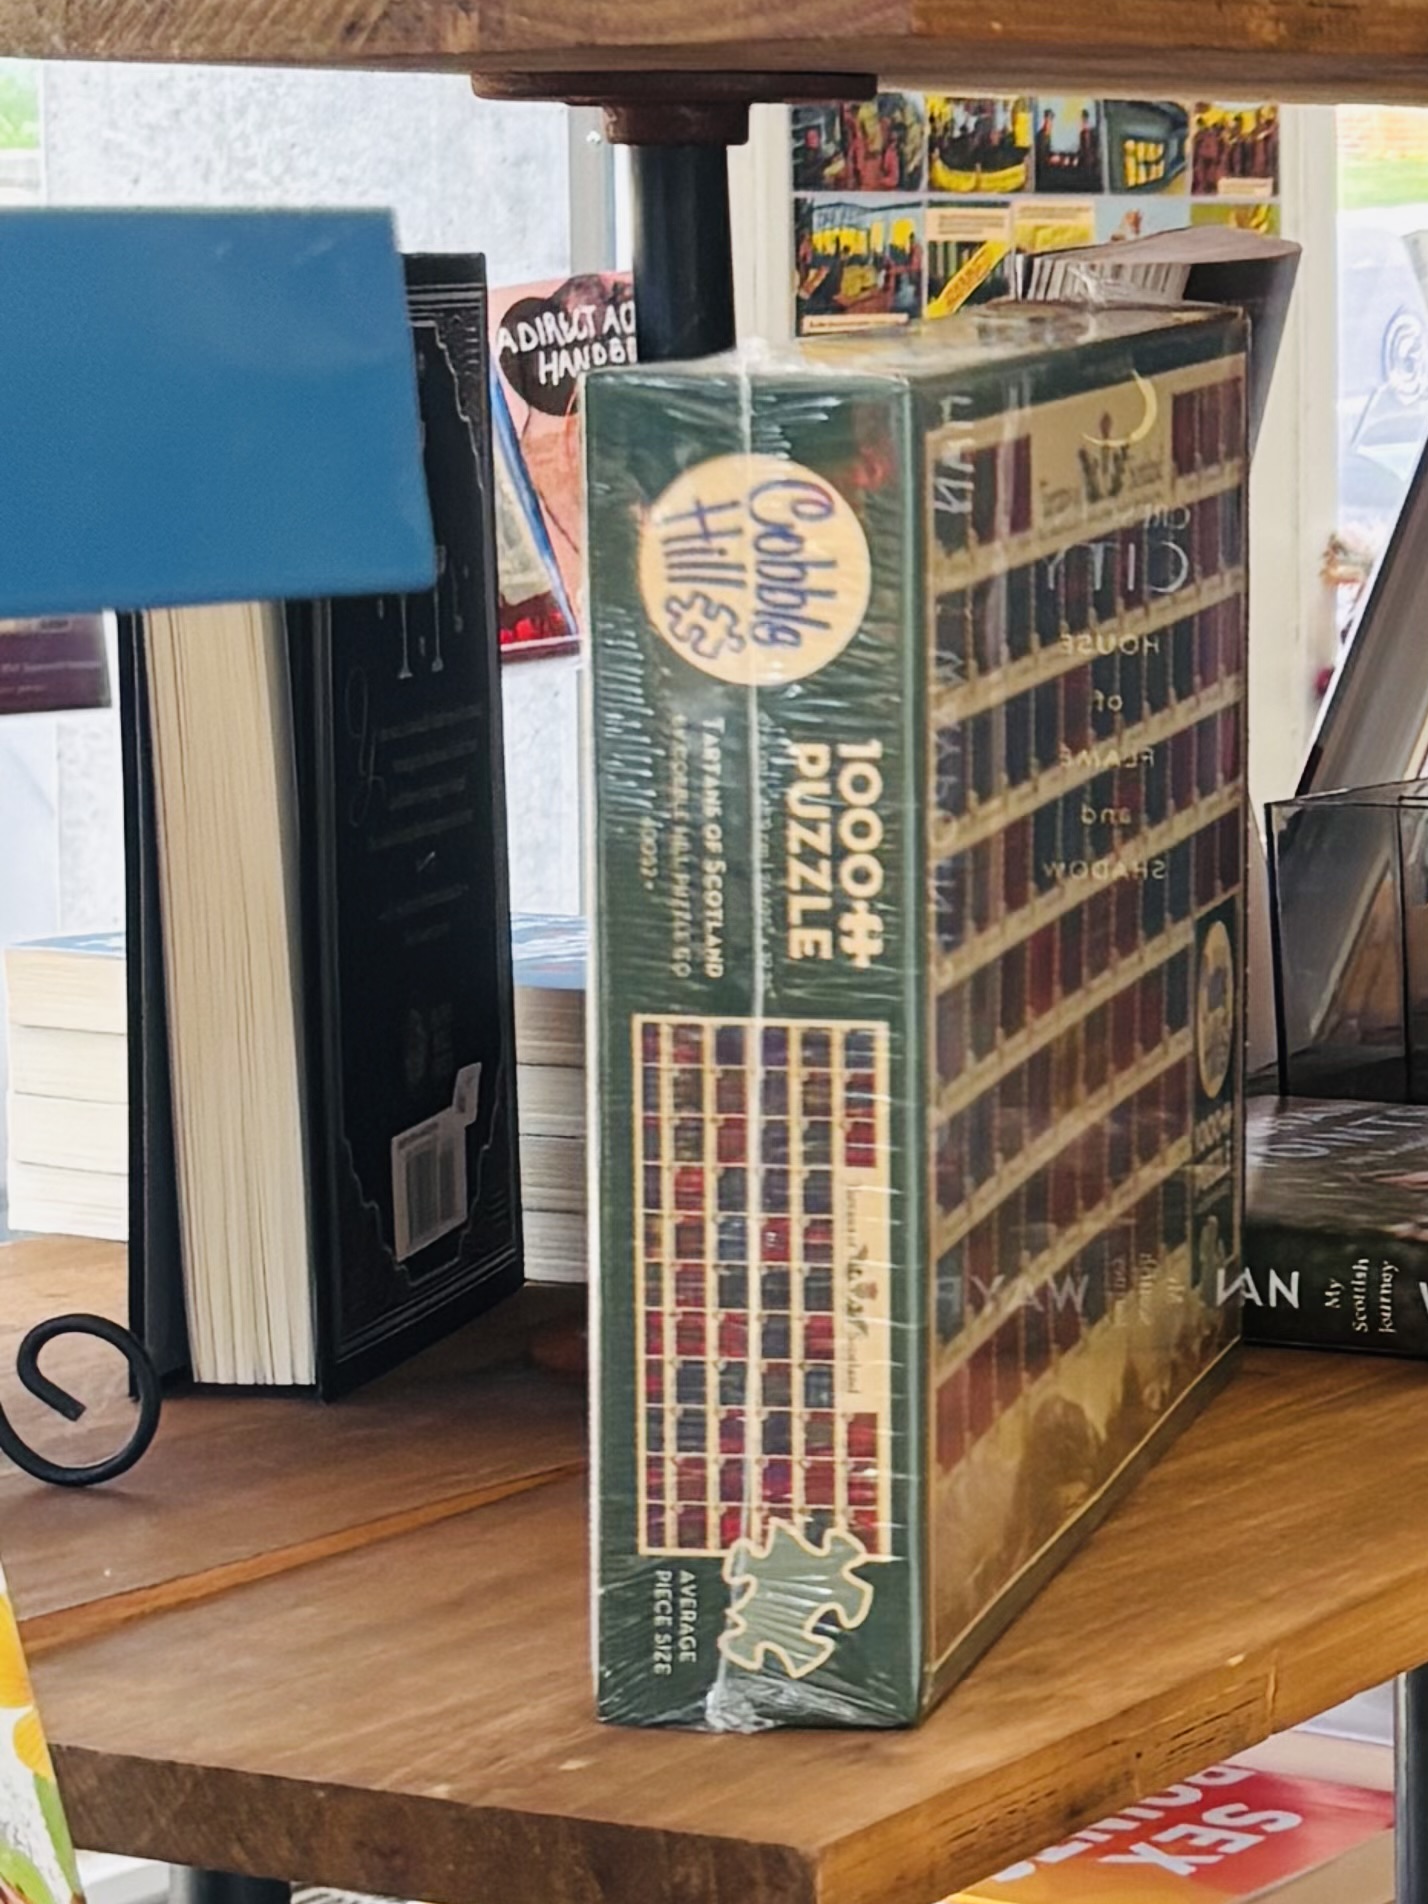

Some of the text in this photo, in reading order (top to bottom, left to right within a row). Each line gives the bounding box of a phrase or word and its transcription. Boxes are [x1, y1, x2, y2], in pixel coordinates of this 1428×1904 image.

[663, 496, 749, 595] Hill
[749, 479, 836, 652] Cobble
[702, 823, 727, 978] OF SCOTLAND
[788, 741, 832, 962] PUZZLE
[1325, 1277, 1346, 1309] My
[1352, 1258, 1370, 1334] Scottish
[1379, 1259, 1400, 1334] Journey
[653, 1569, 673, 1677] PIECE SIZE
[680, 1569, 698, 1663] AVERAGE
[1097, 1802, 1303, 1877] SEX
